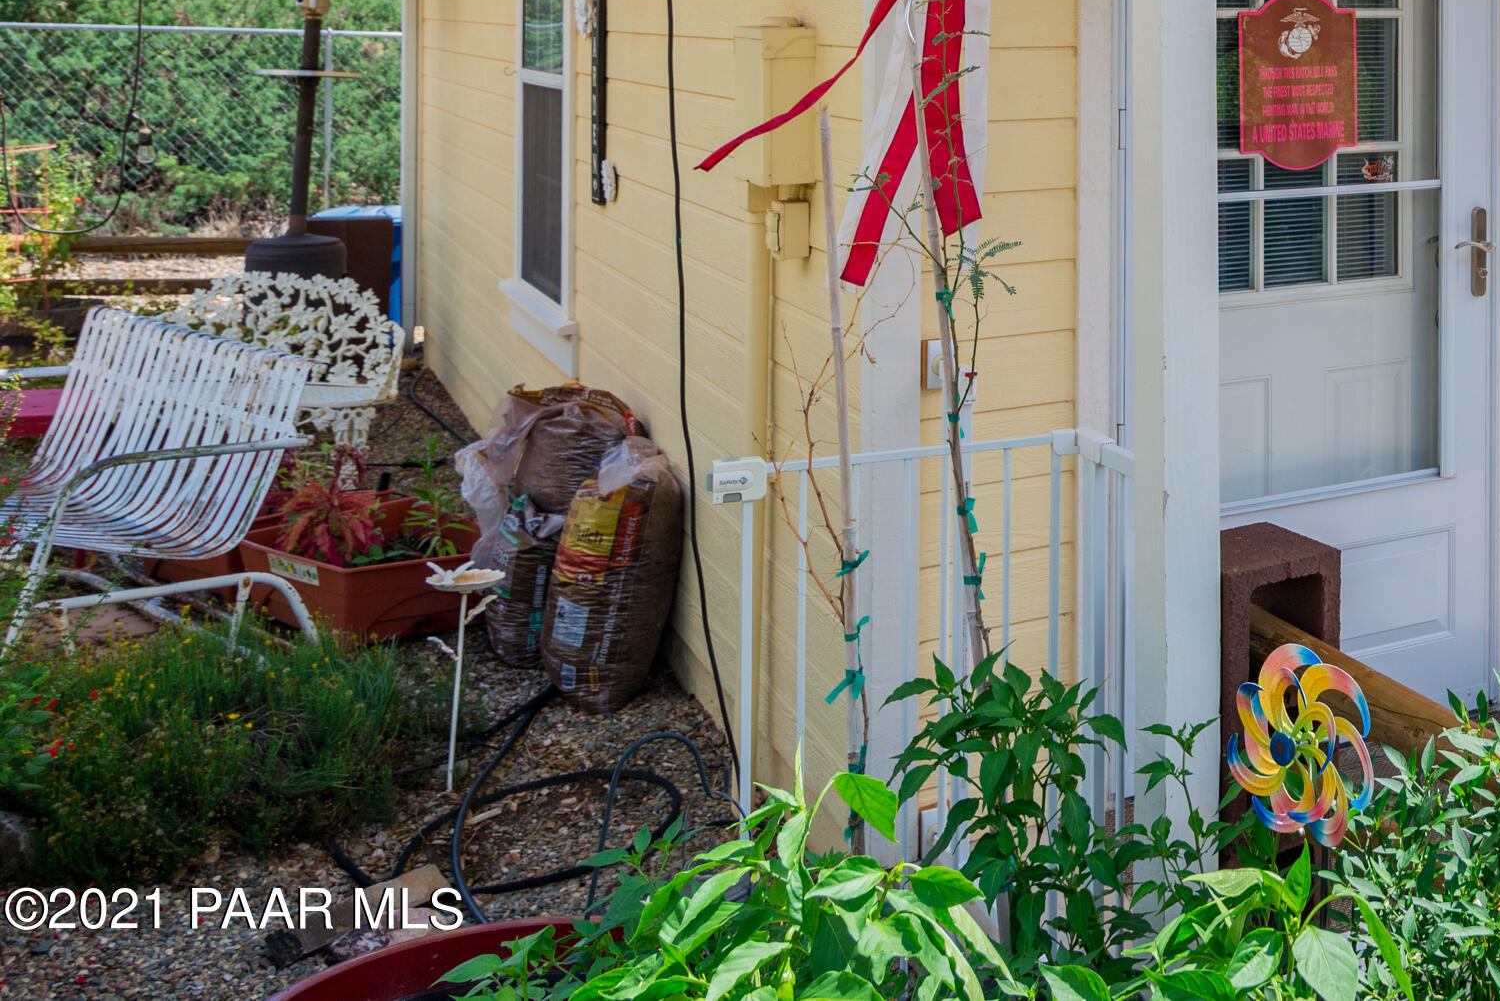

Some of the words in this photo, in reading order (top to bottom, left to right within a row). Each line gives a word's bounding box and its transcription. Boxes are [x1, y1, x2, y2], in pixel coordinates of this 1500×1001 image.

[1283, 66, 1295, 79] THIS
[1324, 64, 1338, 78] PASS
[1262, 86, 1273, 99] THE
[1291, 84, 1306, 97] MOST
[1305, 101, 1315, 115] THE
[1252, 125, 1258, 144] A
[1260, 124, 1287, 143] UNITED
[1288, 121, 1316, 142] STATES
[1317, 119, 1345, 139] MARINE
